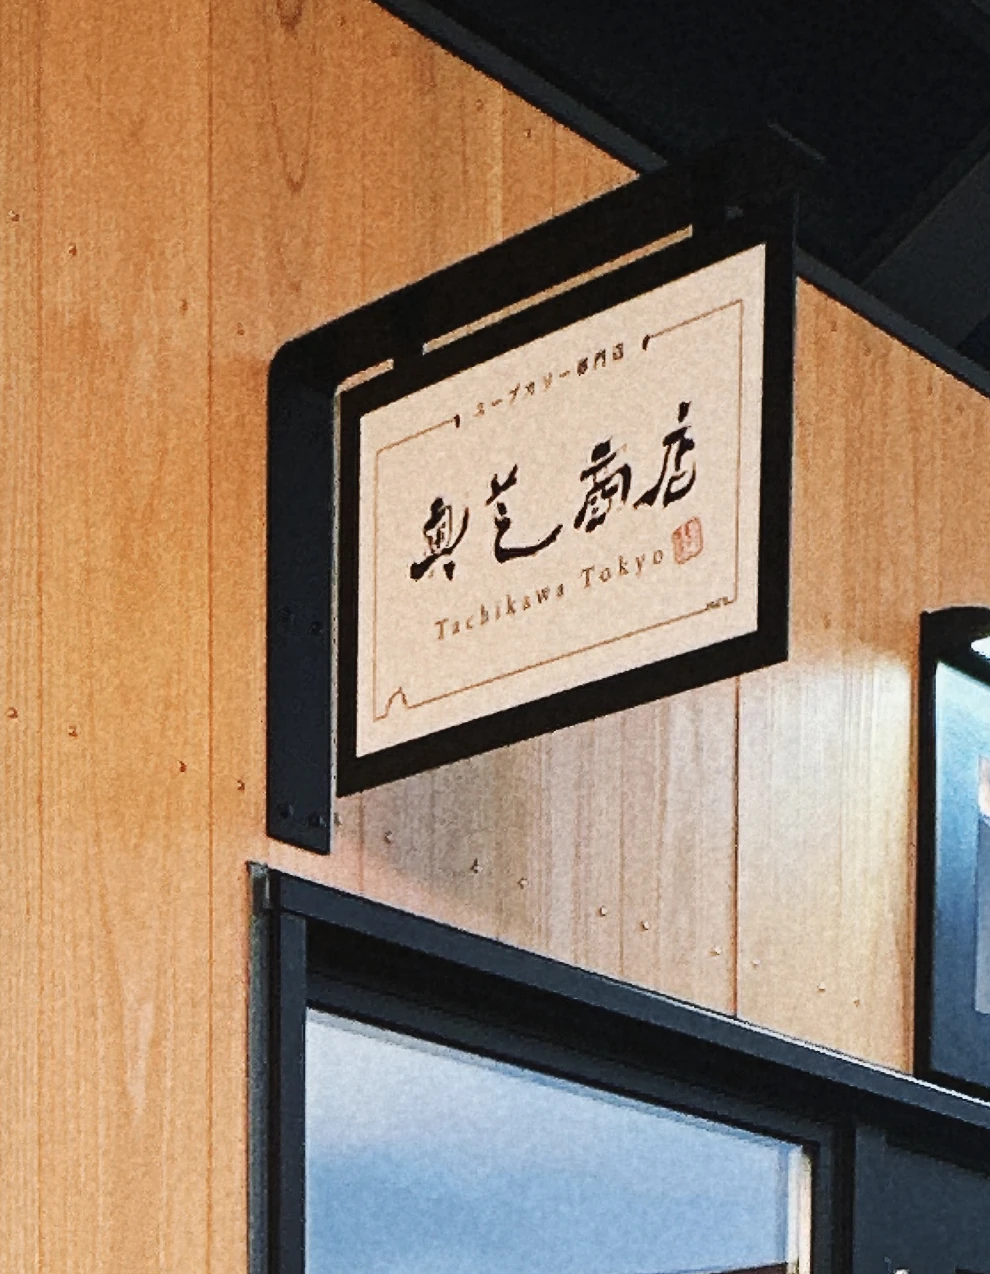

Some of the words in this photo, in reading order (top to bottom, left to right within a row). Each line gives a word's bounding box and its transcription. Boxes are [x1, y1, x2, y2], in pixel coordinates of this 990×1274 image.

[408, 401, 697, 582] 奥芝商店
[434, 583, 565, 640] Tachikawa
[580, 548, 664, 589] Tokyo
